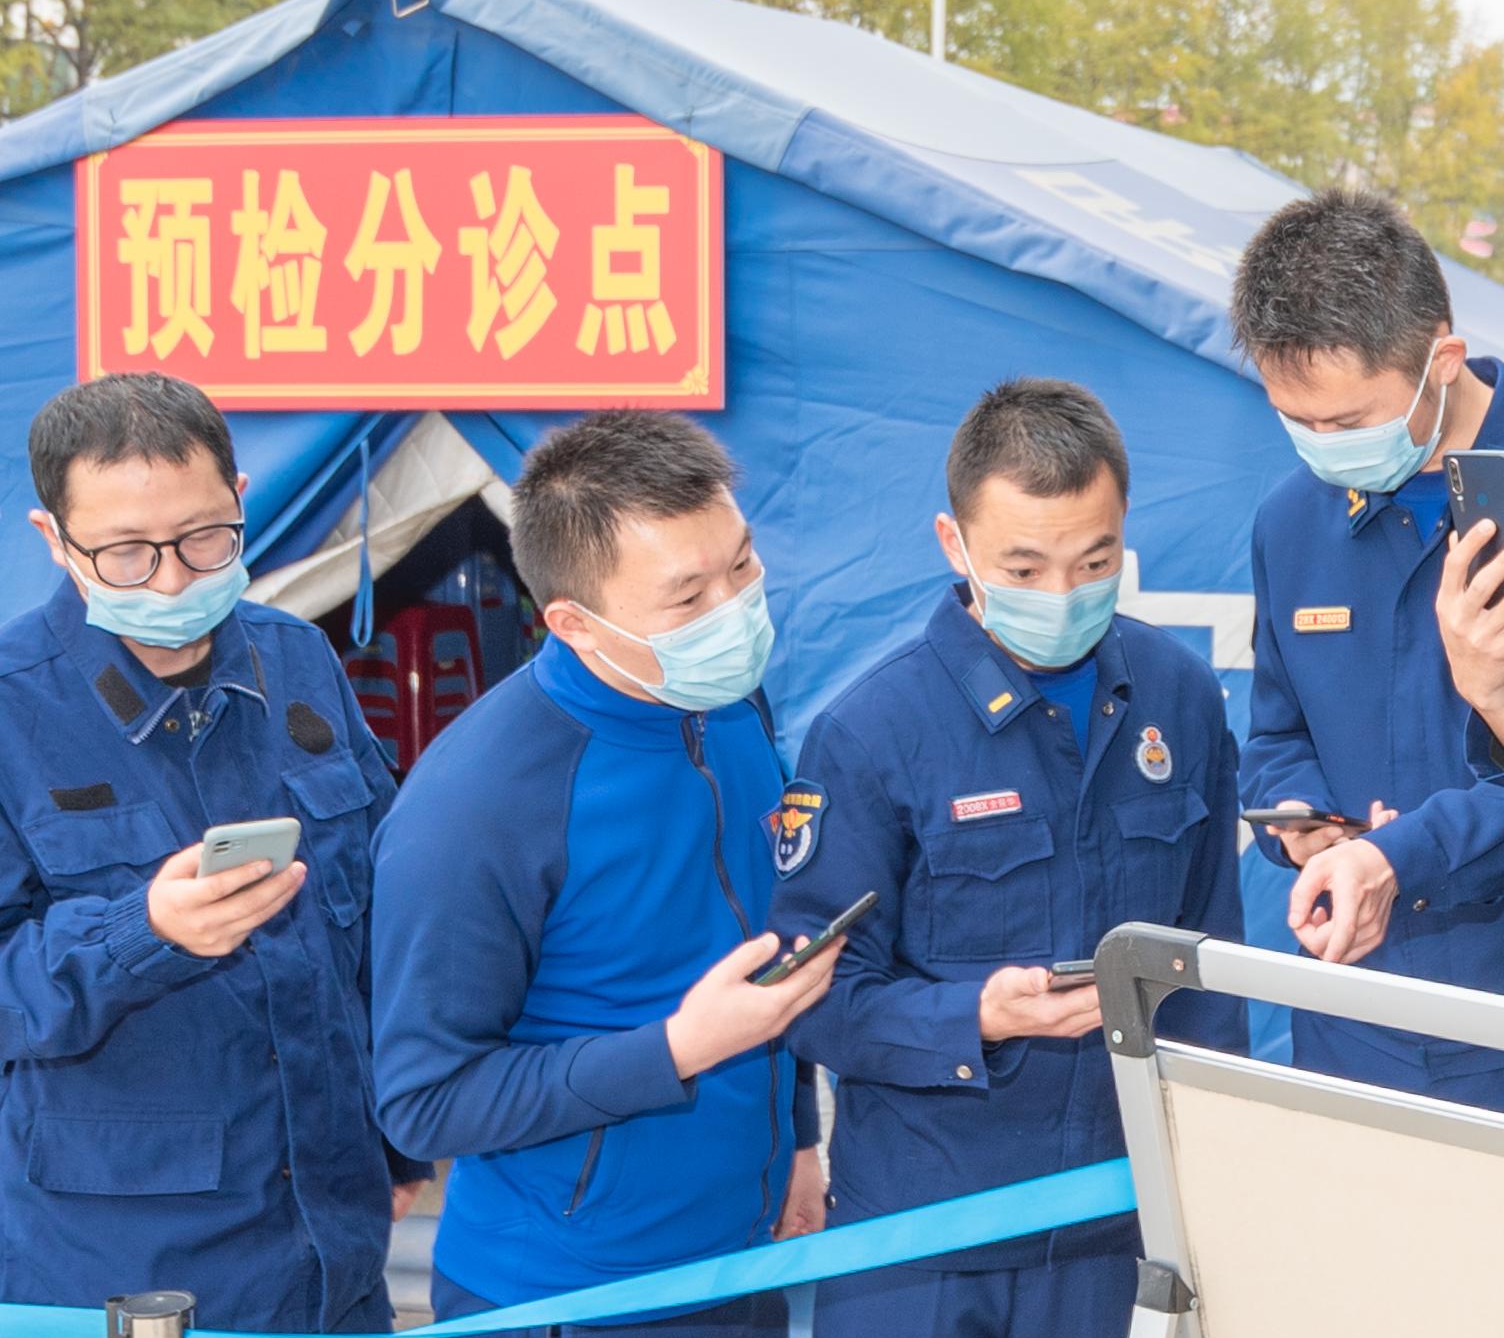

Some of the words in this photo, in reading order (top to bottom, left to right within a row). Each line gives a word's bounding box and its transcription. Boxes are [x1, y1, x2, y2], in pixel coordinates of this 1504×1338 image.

[117, 163, 678, 361] 预检分诊点
